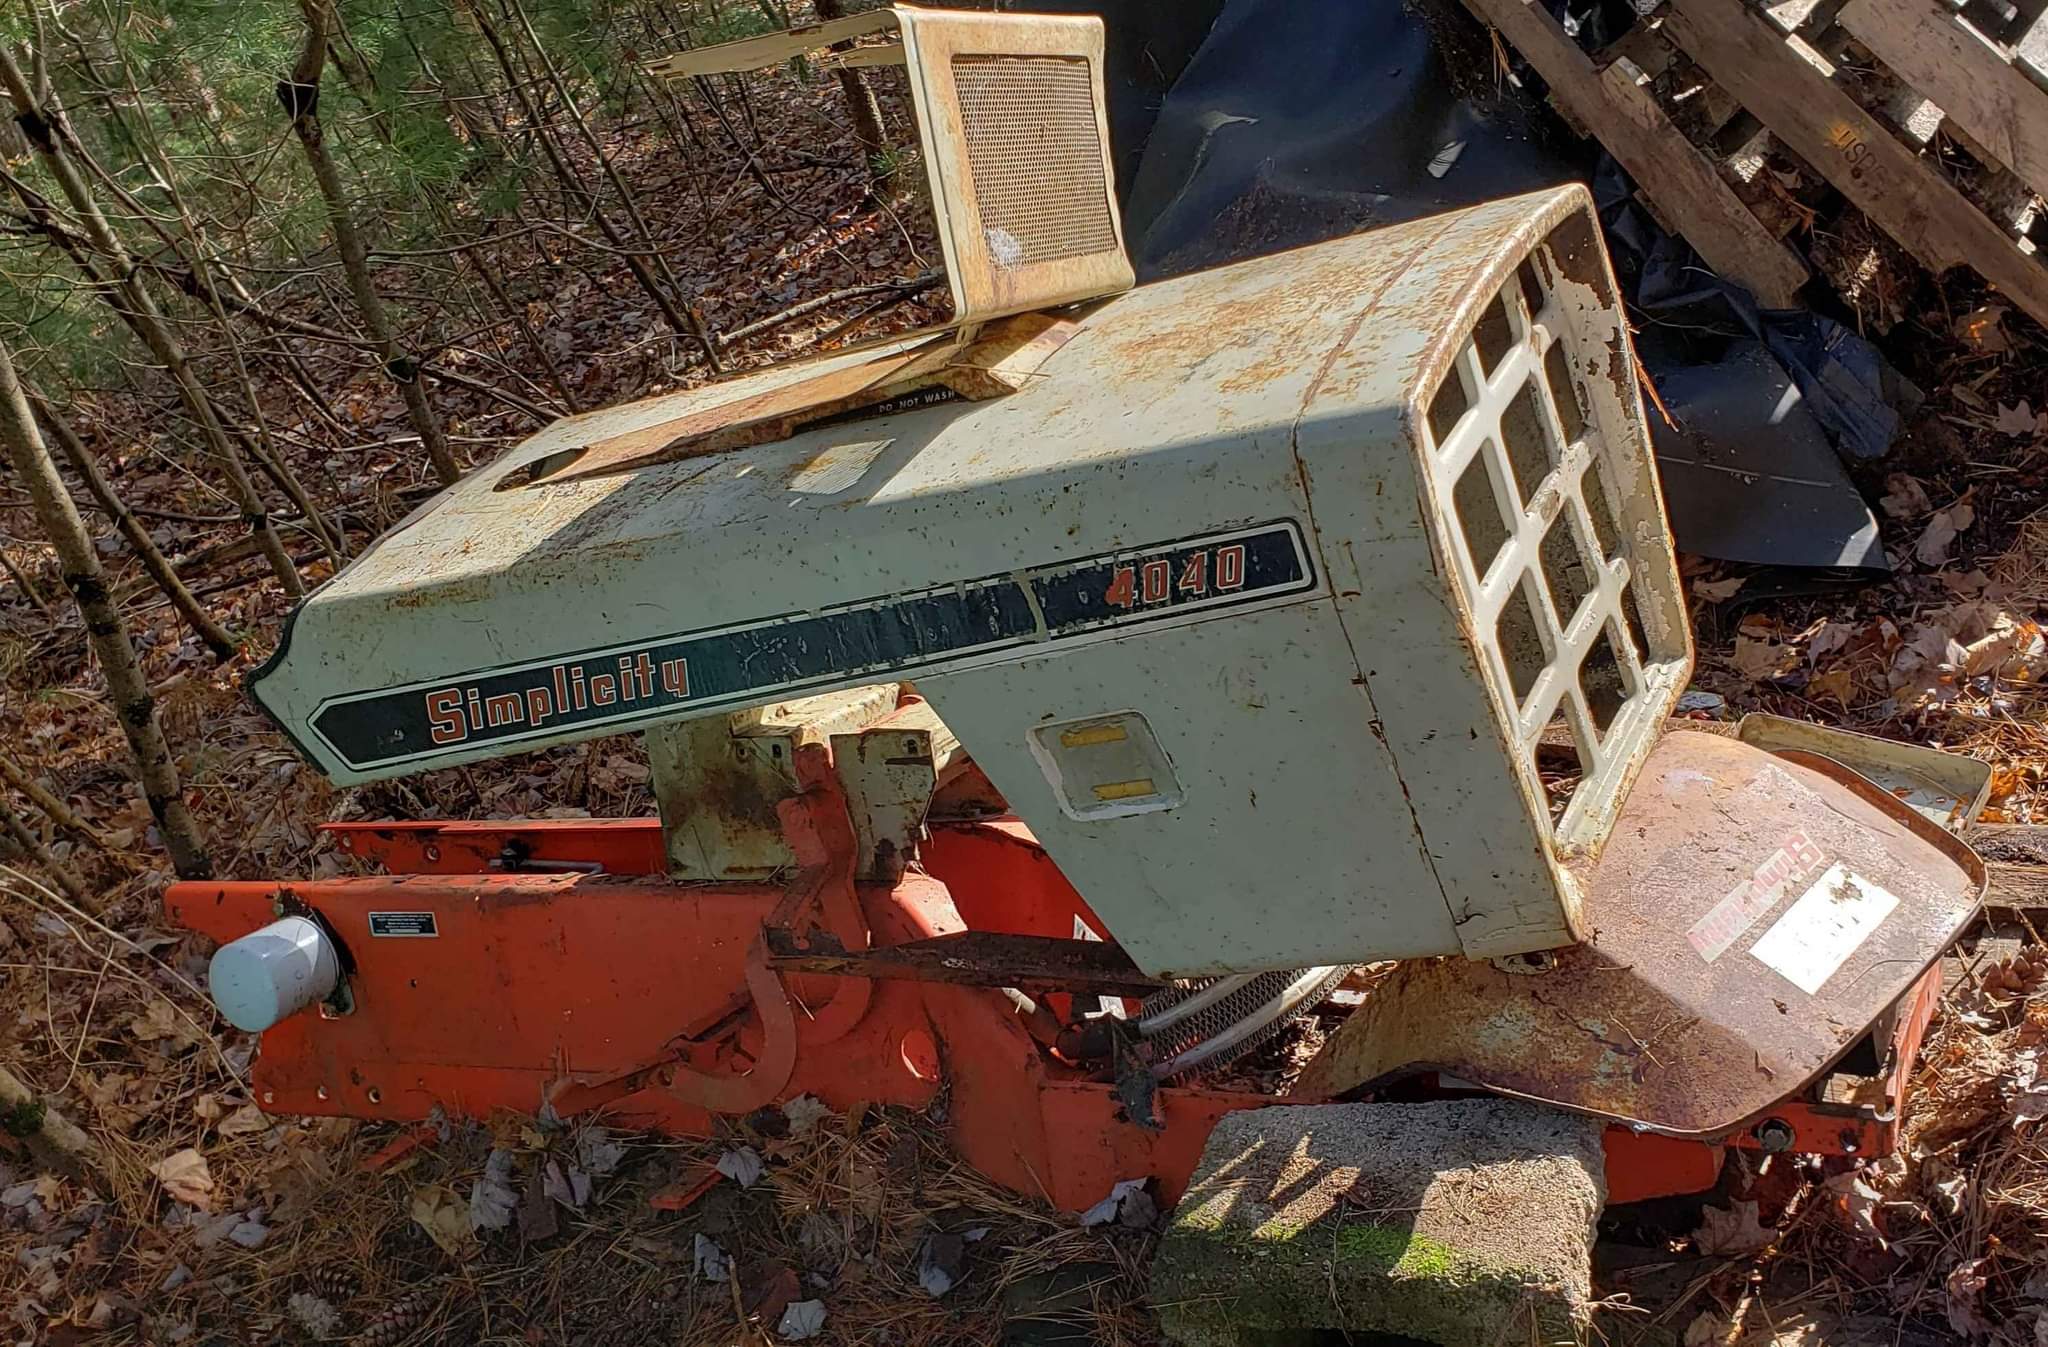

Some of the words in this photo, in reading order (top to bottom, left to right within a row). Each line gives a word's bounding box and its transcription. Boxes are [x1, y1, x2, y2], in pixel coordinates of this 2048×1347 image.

[879, 403, 893, 412] DO
[899, 397, 919, 408] NOT
[924, 390, 955, 403] WASH
[425, 652, 690, 745] Simplicity
[1104, 545, 1245, 608] 4040
